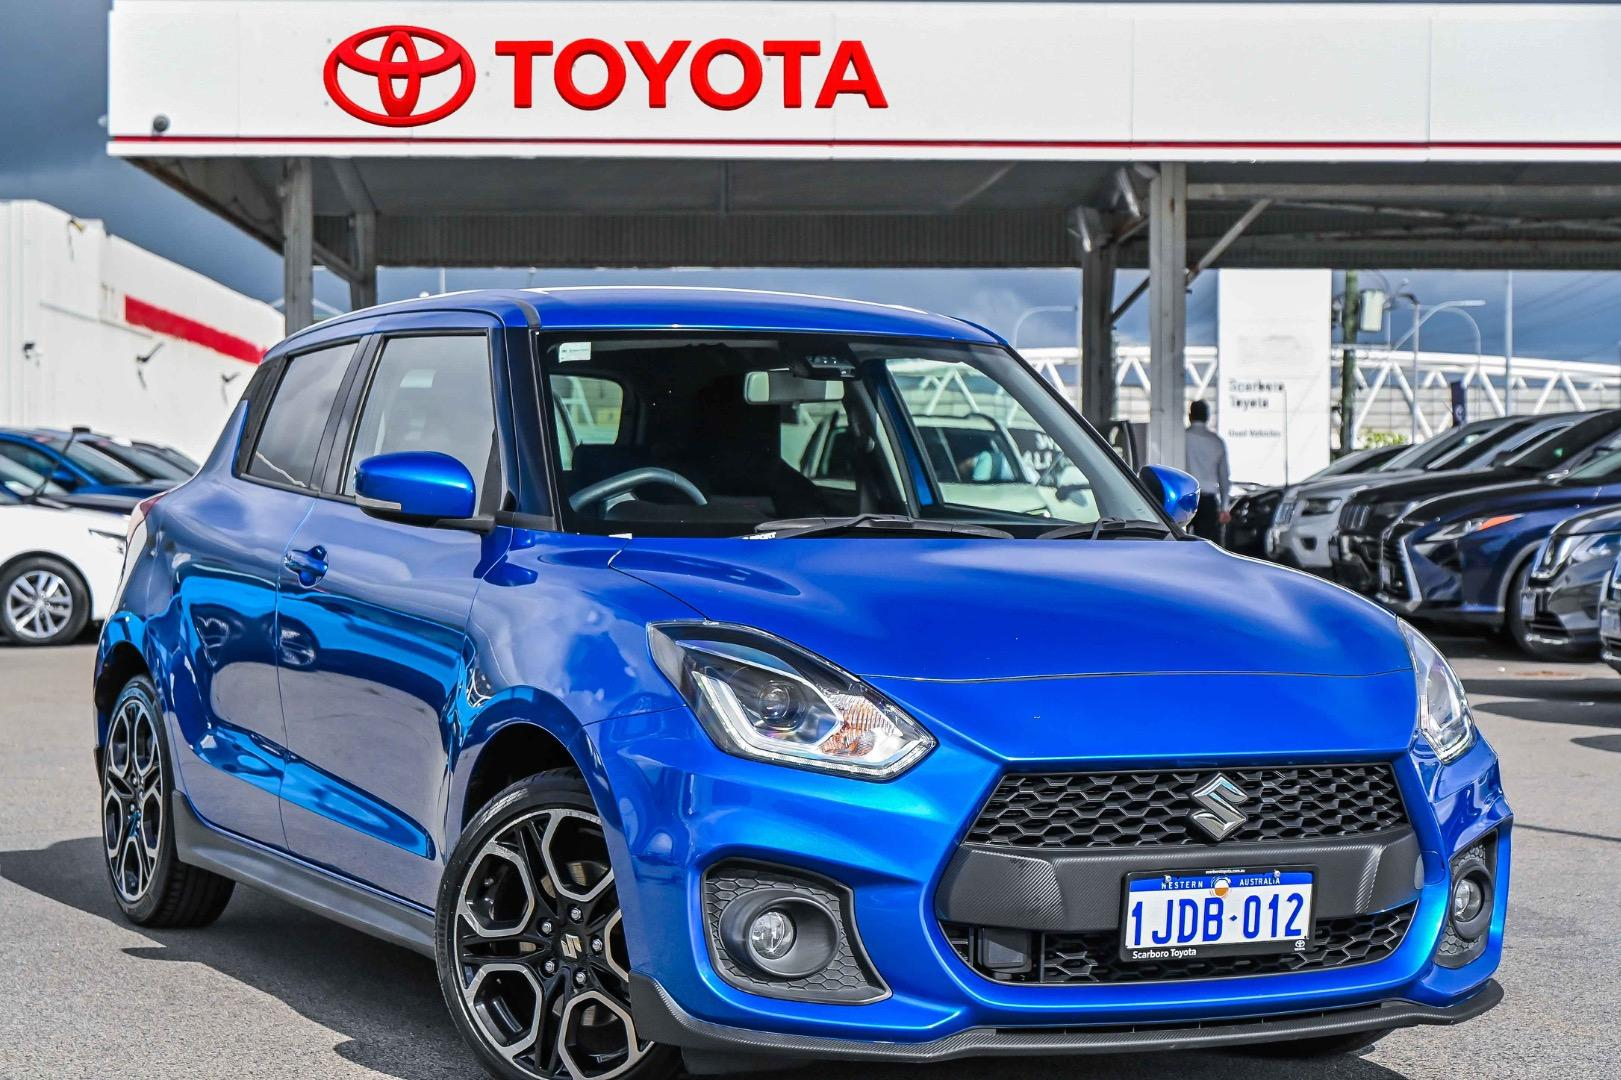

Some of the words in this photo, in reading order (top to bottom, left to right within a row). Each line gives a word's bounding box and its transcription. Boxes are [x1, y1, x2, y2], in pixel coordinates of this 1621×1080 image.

[495, 38, 888, 111] TOYOTA
[1161, 880, 1203, 890] WESTERN
[1239, 877, 1280, 886] AUSTRALIA
[1132, 949, 1169, 959] Scarboro
[1170, 947, 1197, 958] Toyota
